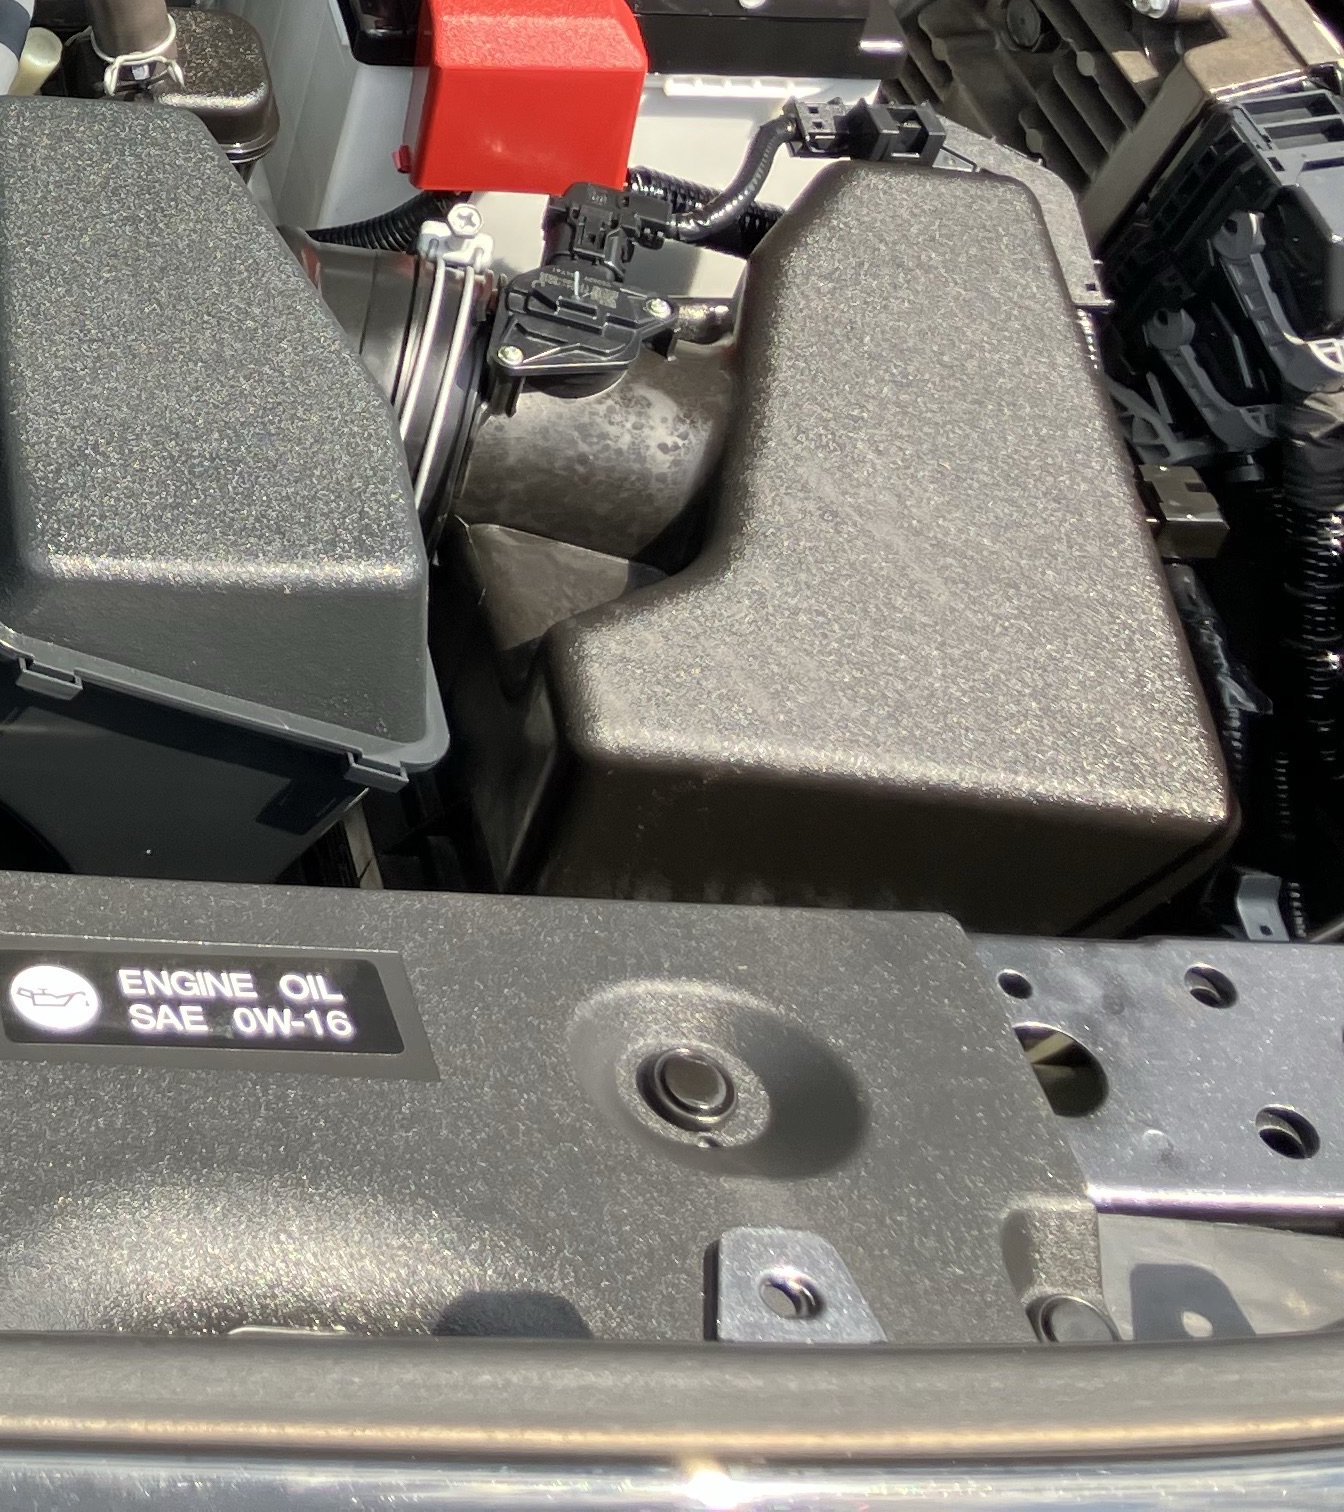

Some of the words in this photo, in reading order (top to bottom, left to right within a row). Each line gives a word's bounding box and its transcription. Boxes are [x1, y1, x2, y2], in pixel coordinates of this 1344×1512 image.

[117, 968, 257, 999] ENGINE
[278, 973, 345, 1003] OIL
[128, 1003, 209, 1034] SAE
[231, 1008, 354, 1039] 0W-16
